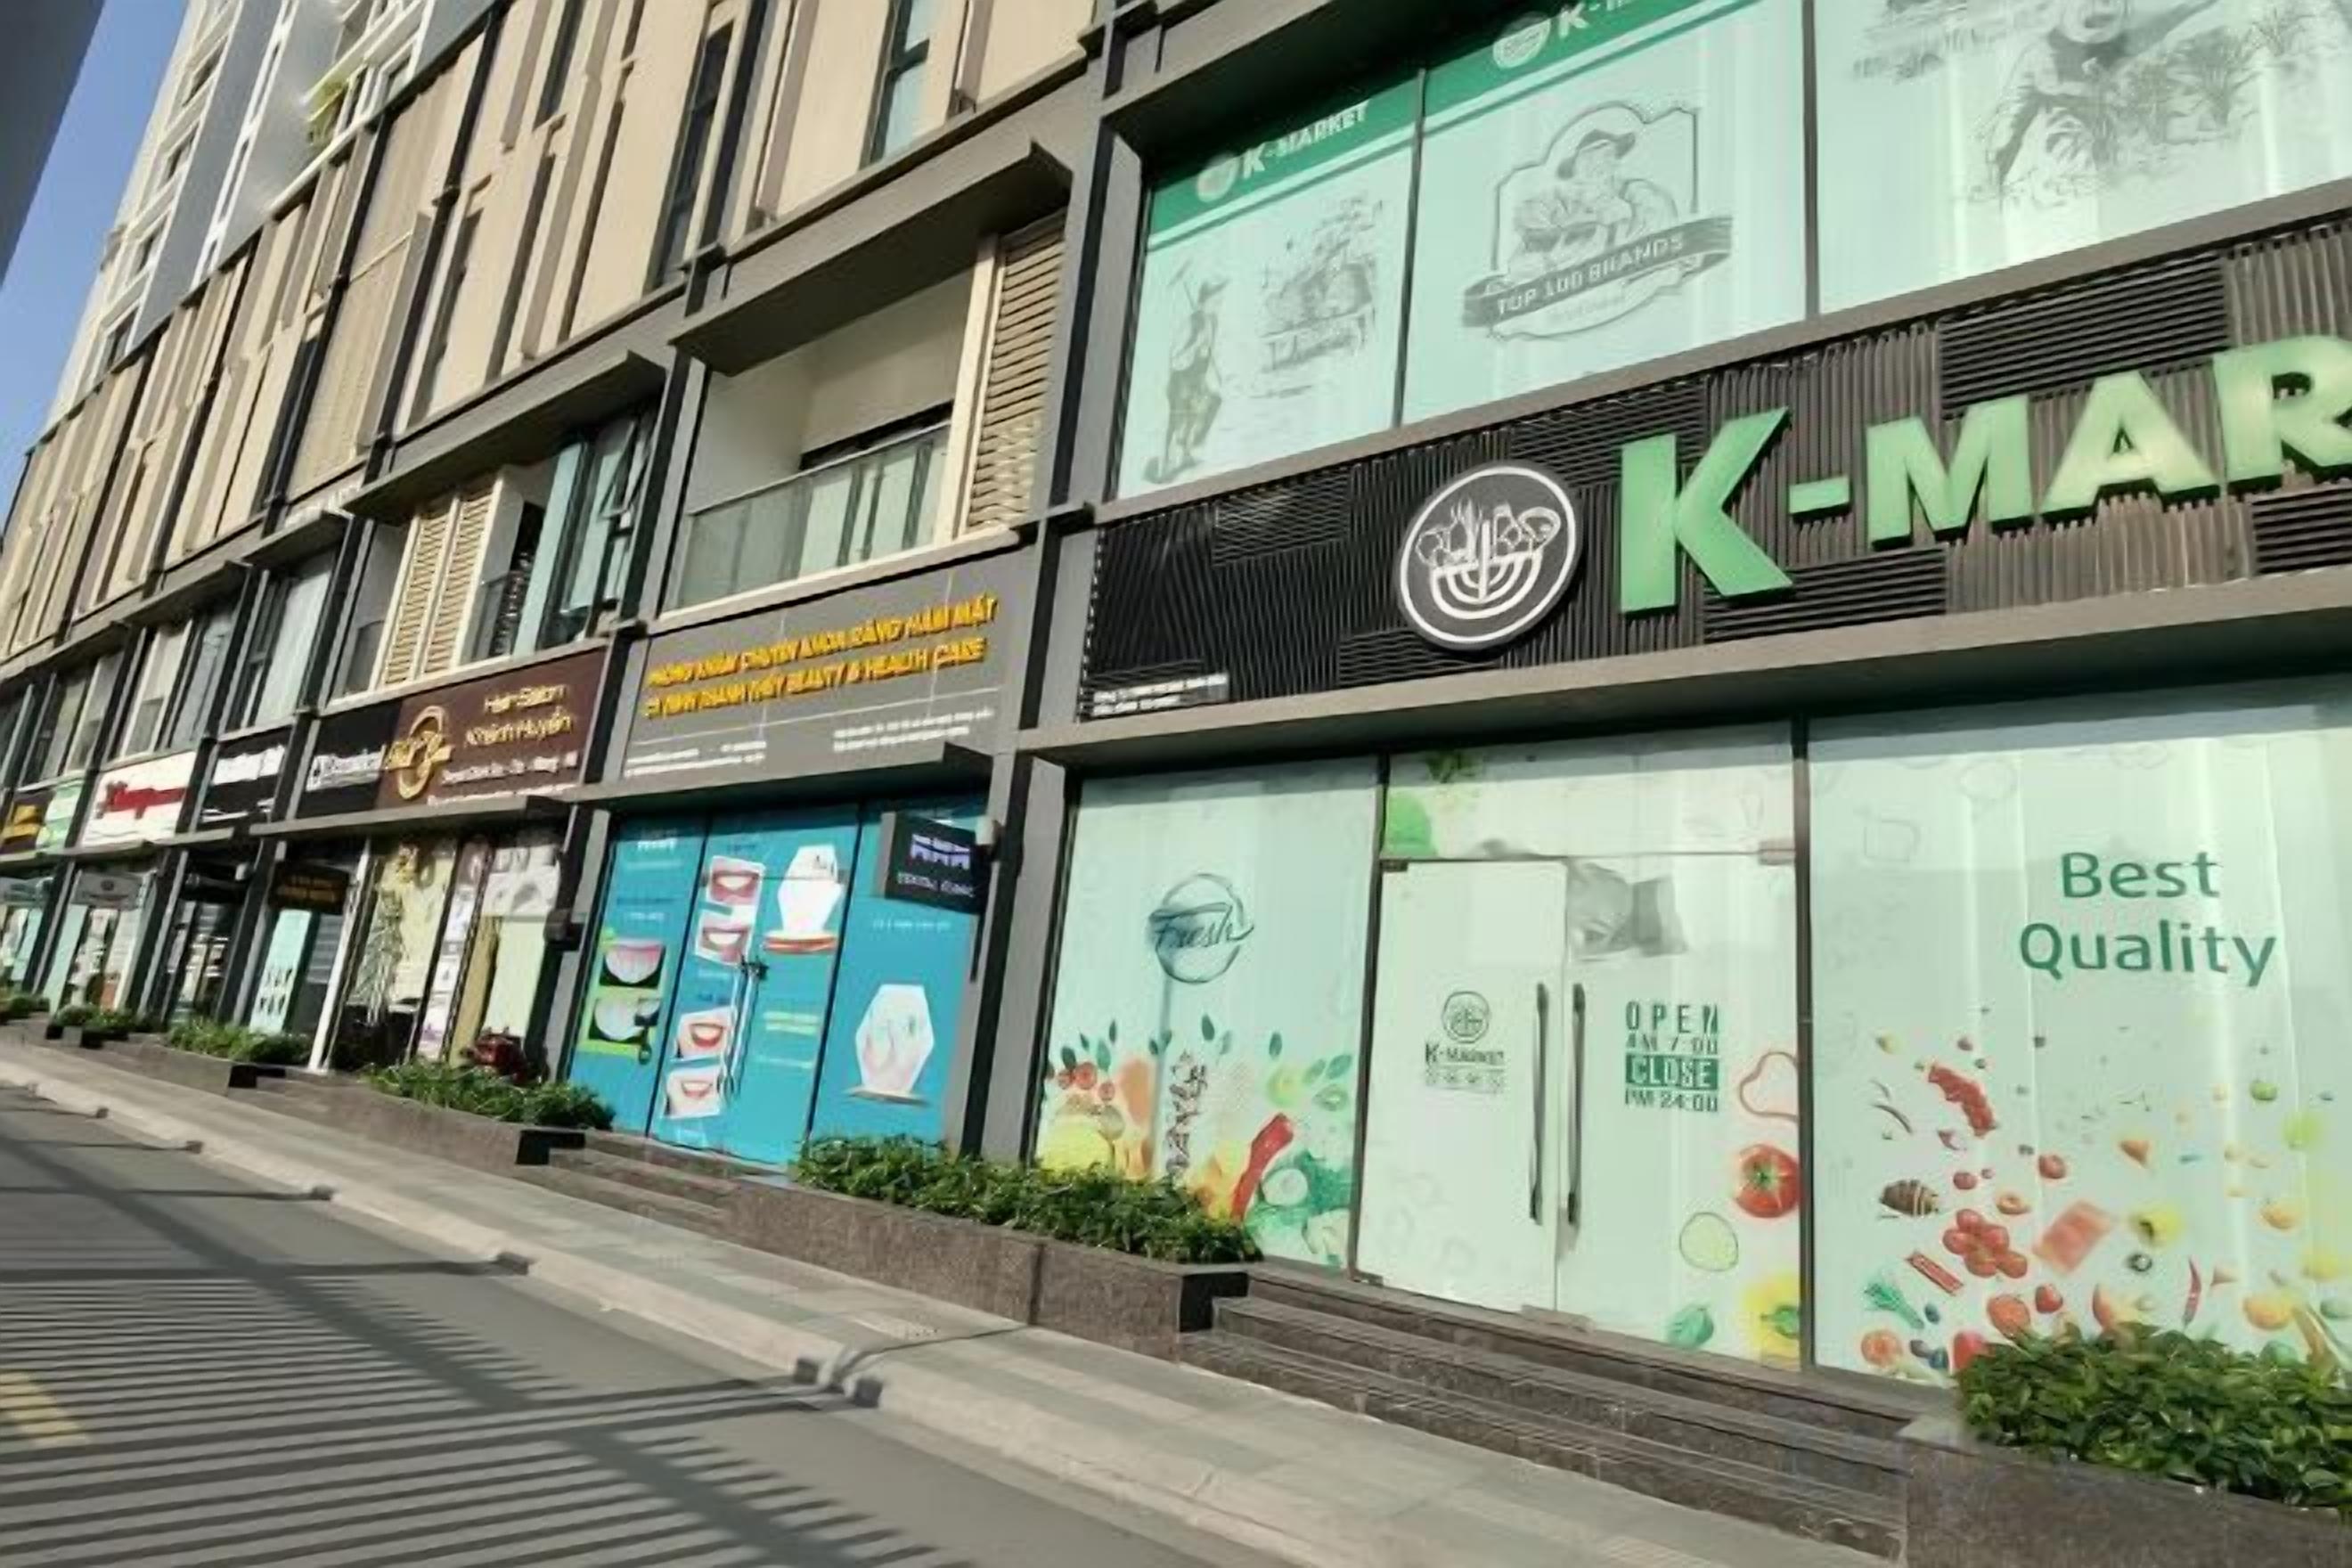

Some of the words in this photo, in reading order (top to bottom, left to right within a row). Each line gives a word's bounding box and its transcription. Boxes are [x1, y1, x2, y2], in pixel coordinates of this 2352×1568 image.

[1498, 288, 1537, 314] TOP
[1588, 236, 1686, 277] BRANDS
[1620, 333, 2352, 617] K-MAR
[2061, 851, 2222, 898] Best
[2019, 919, 2278, 988] Quality
[1625, 1000, 1718, 1033] OPEN
[1631, 1058, 1712, 1087] CLOSE
